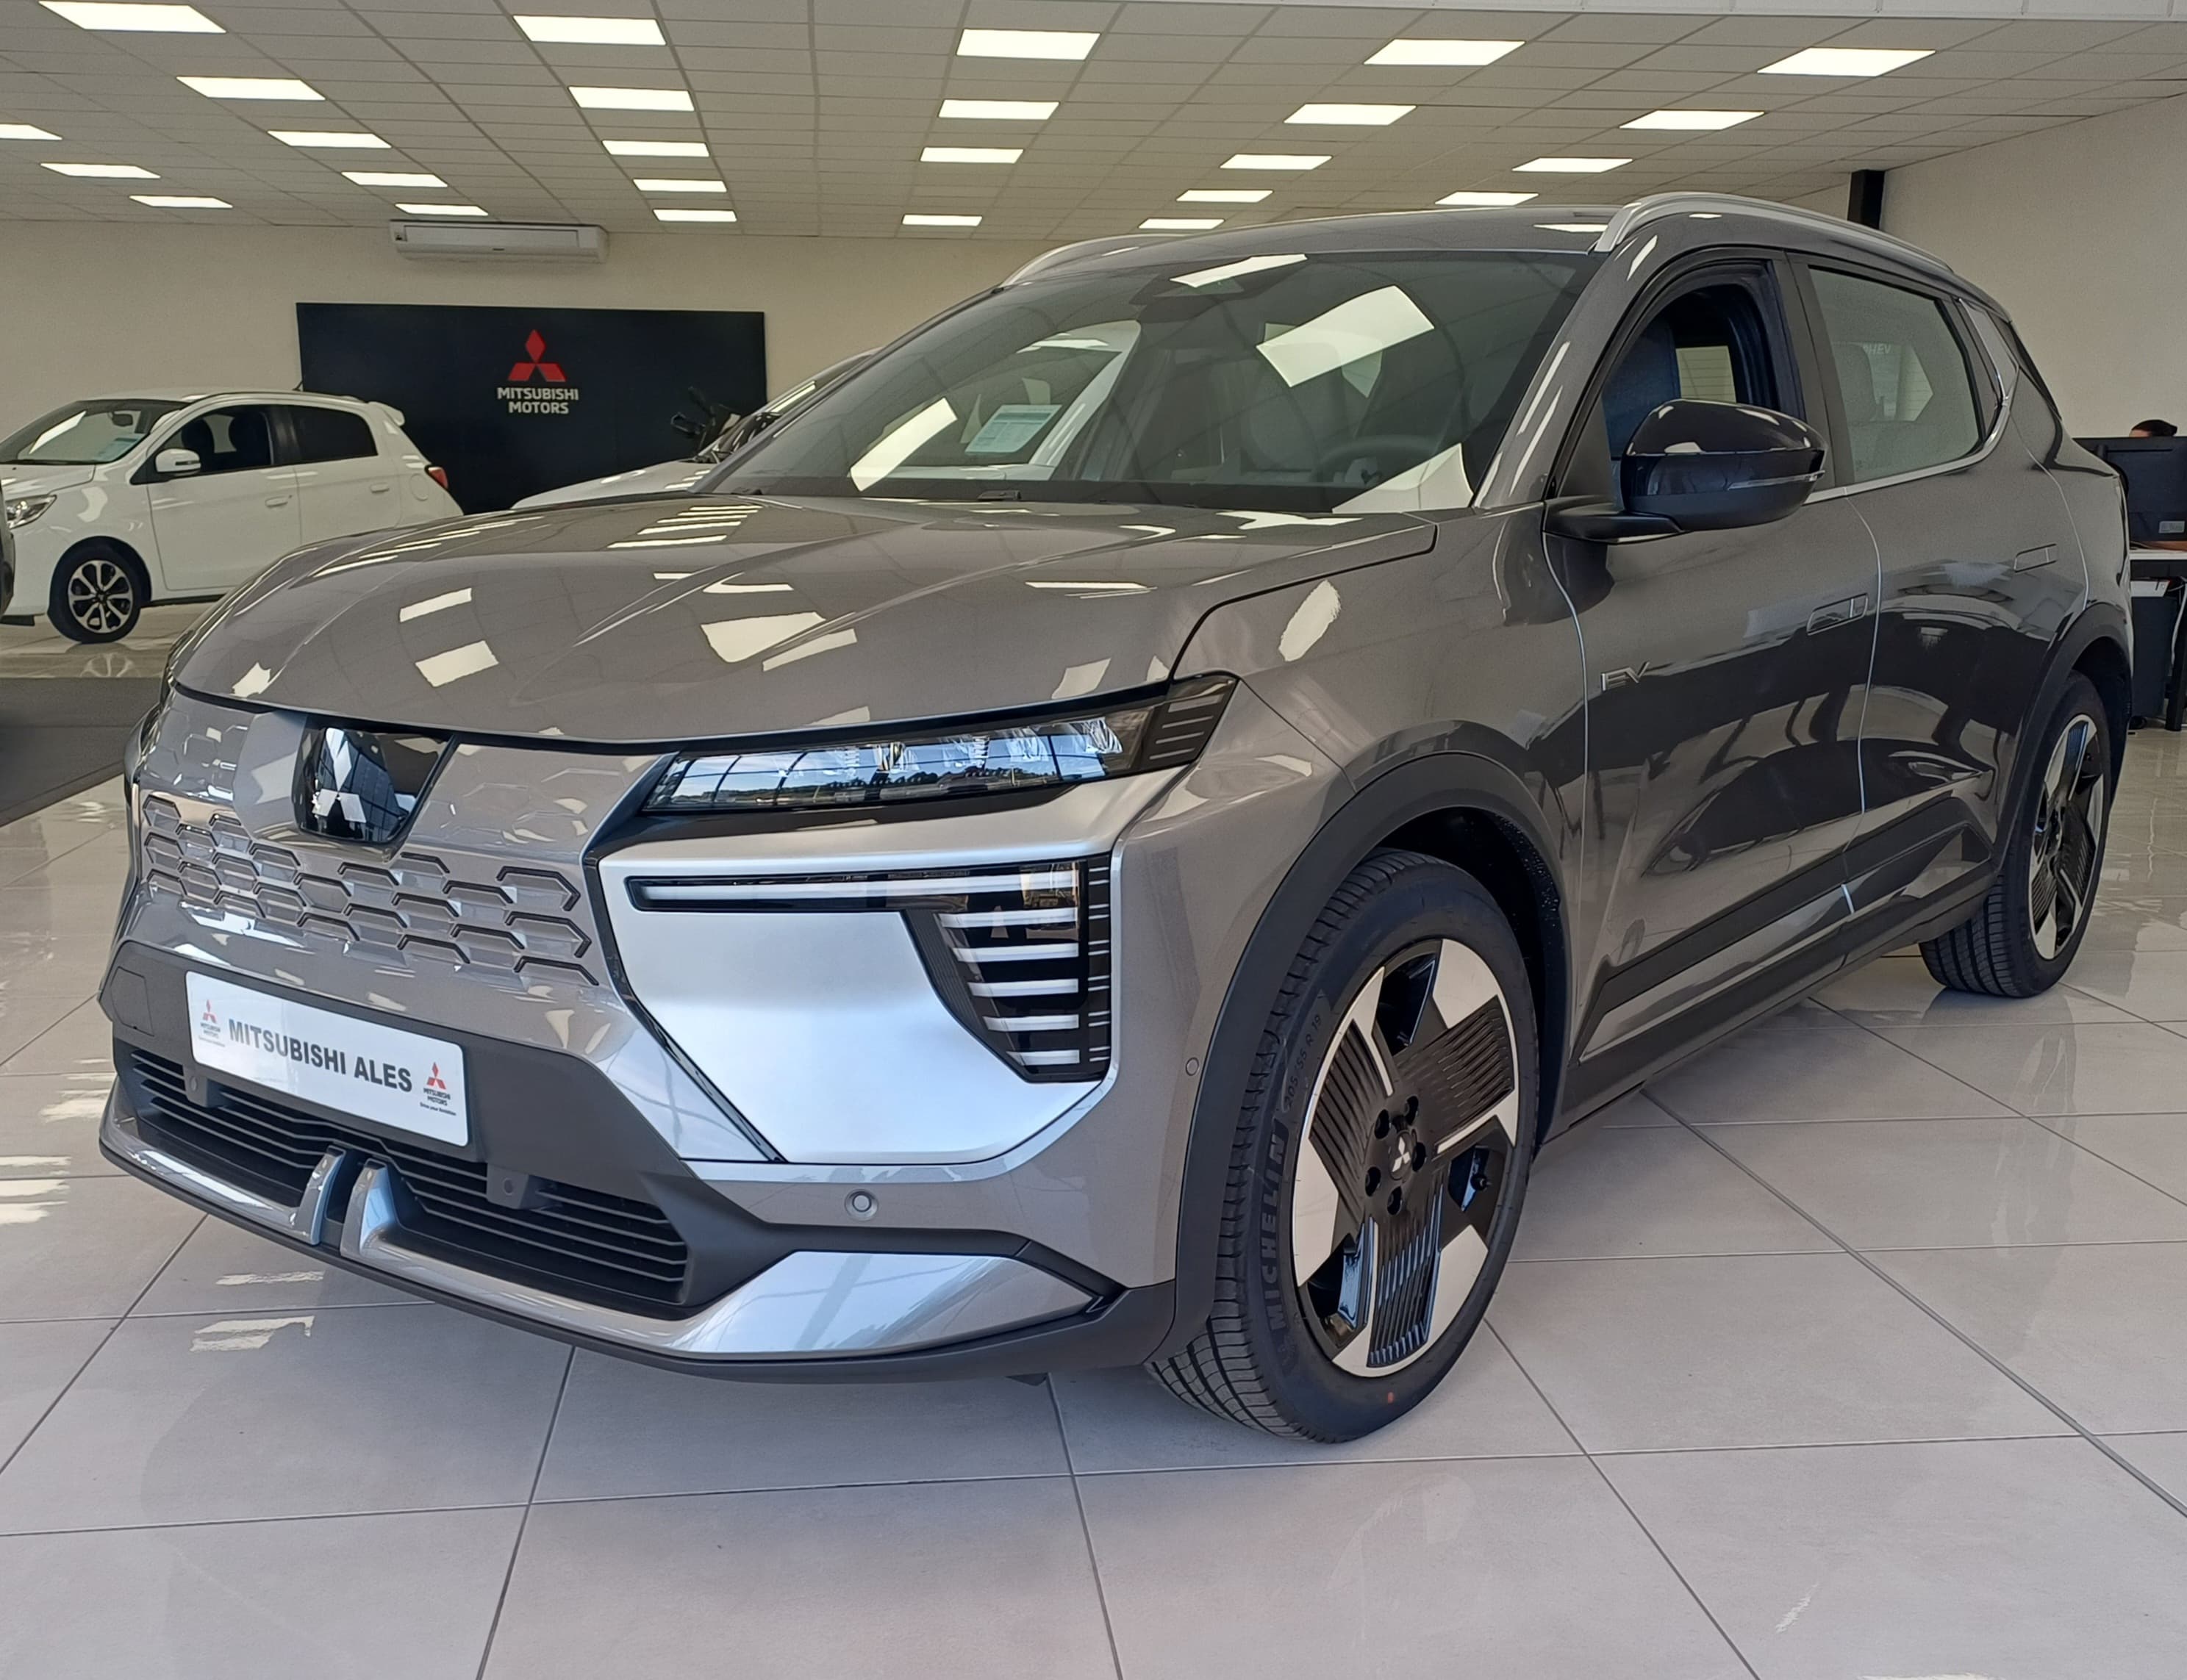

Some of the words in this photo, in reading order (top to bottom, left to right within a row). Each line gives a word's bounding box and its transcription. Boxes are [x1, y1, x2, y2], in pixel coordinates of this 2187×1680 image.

[497, 387, 579, 401] MITSUBISHI
[508, 401, 570, 414] MOTORS
[1600, 661, 1650, 692] EV
[229, 1019, 346, 1074] MITSUBISHI
[354, 1056, 412, 1093] ALES
[1261, 1132, 1286, 1331] MICHELIN
